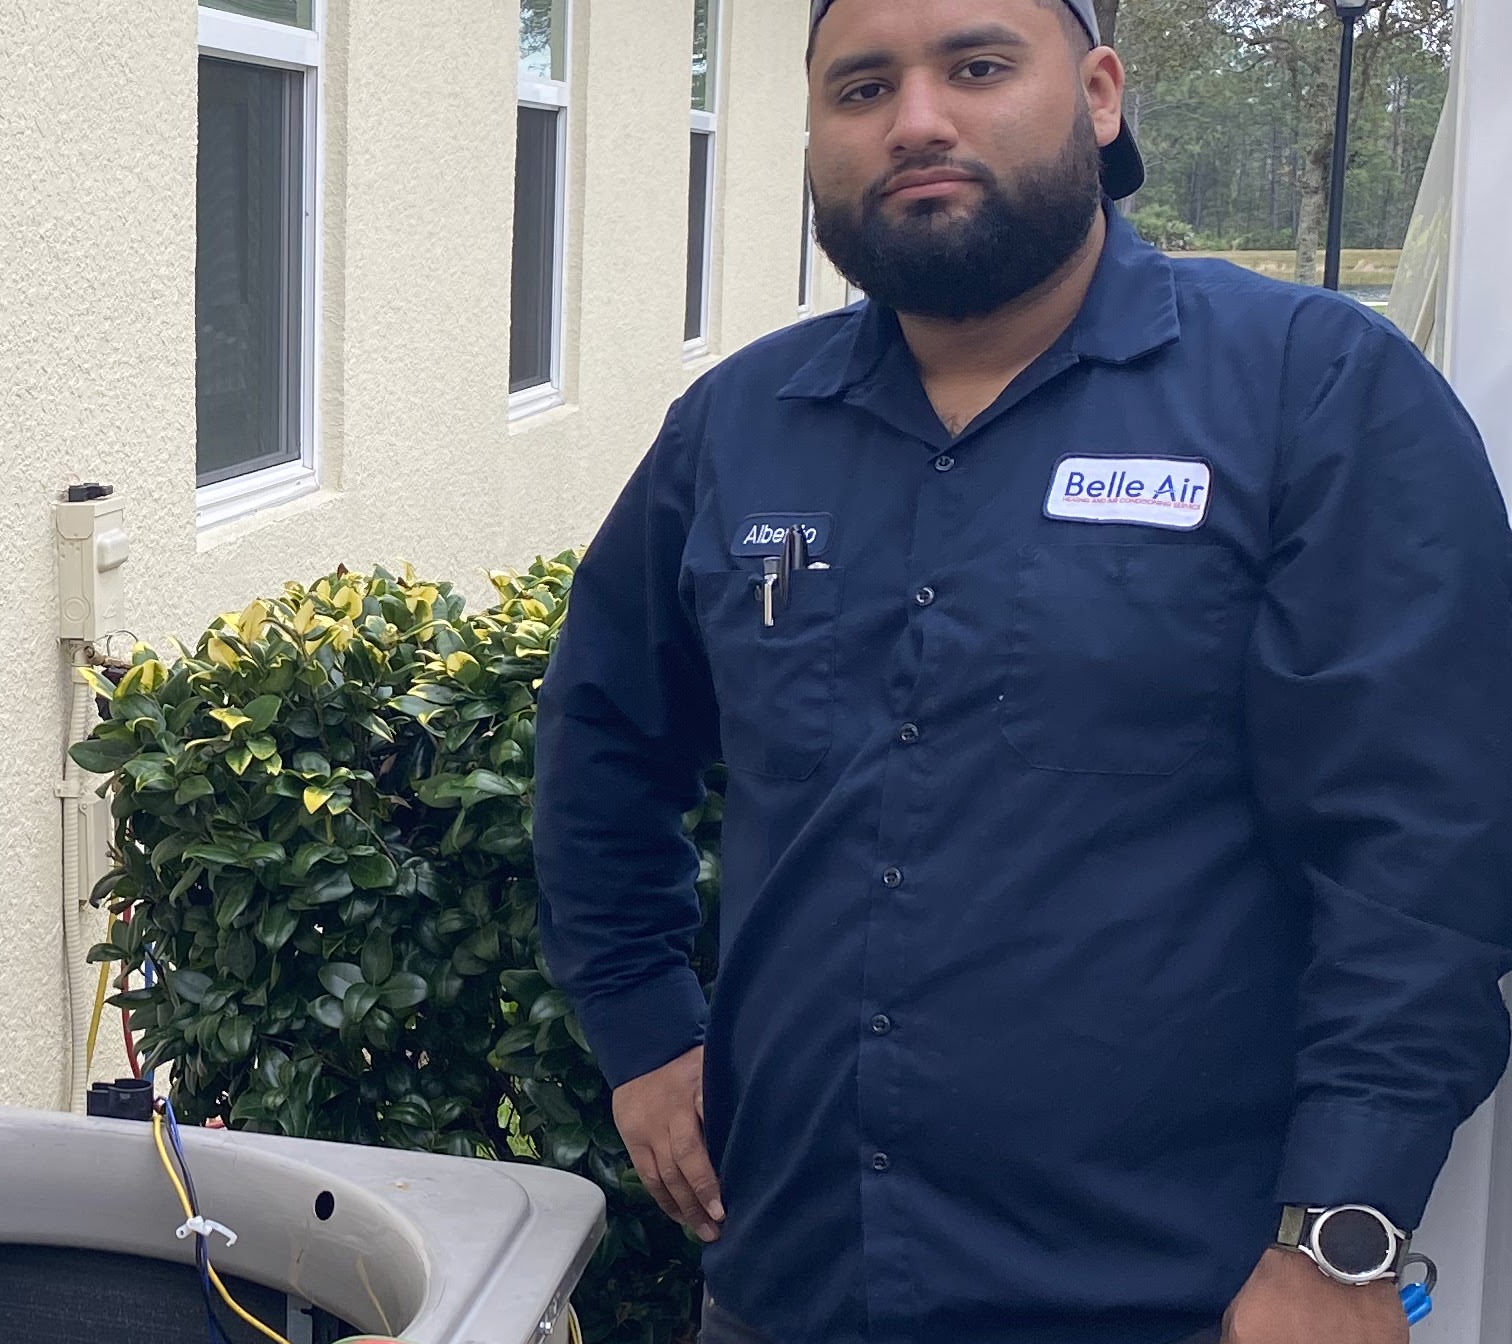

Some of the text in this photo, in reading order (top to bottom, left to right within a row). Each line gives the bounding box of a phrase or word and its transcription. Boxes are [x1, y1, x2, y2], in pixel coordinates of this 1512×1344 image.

[1064, 470, 1205, 504] Belle Air
[742, 523, 817, 544] Albero
